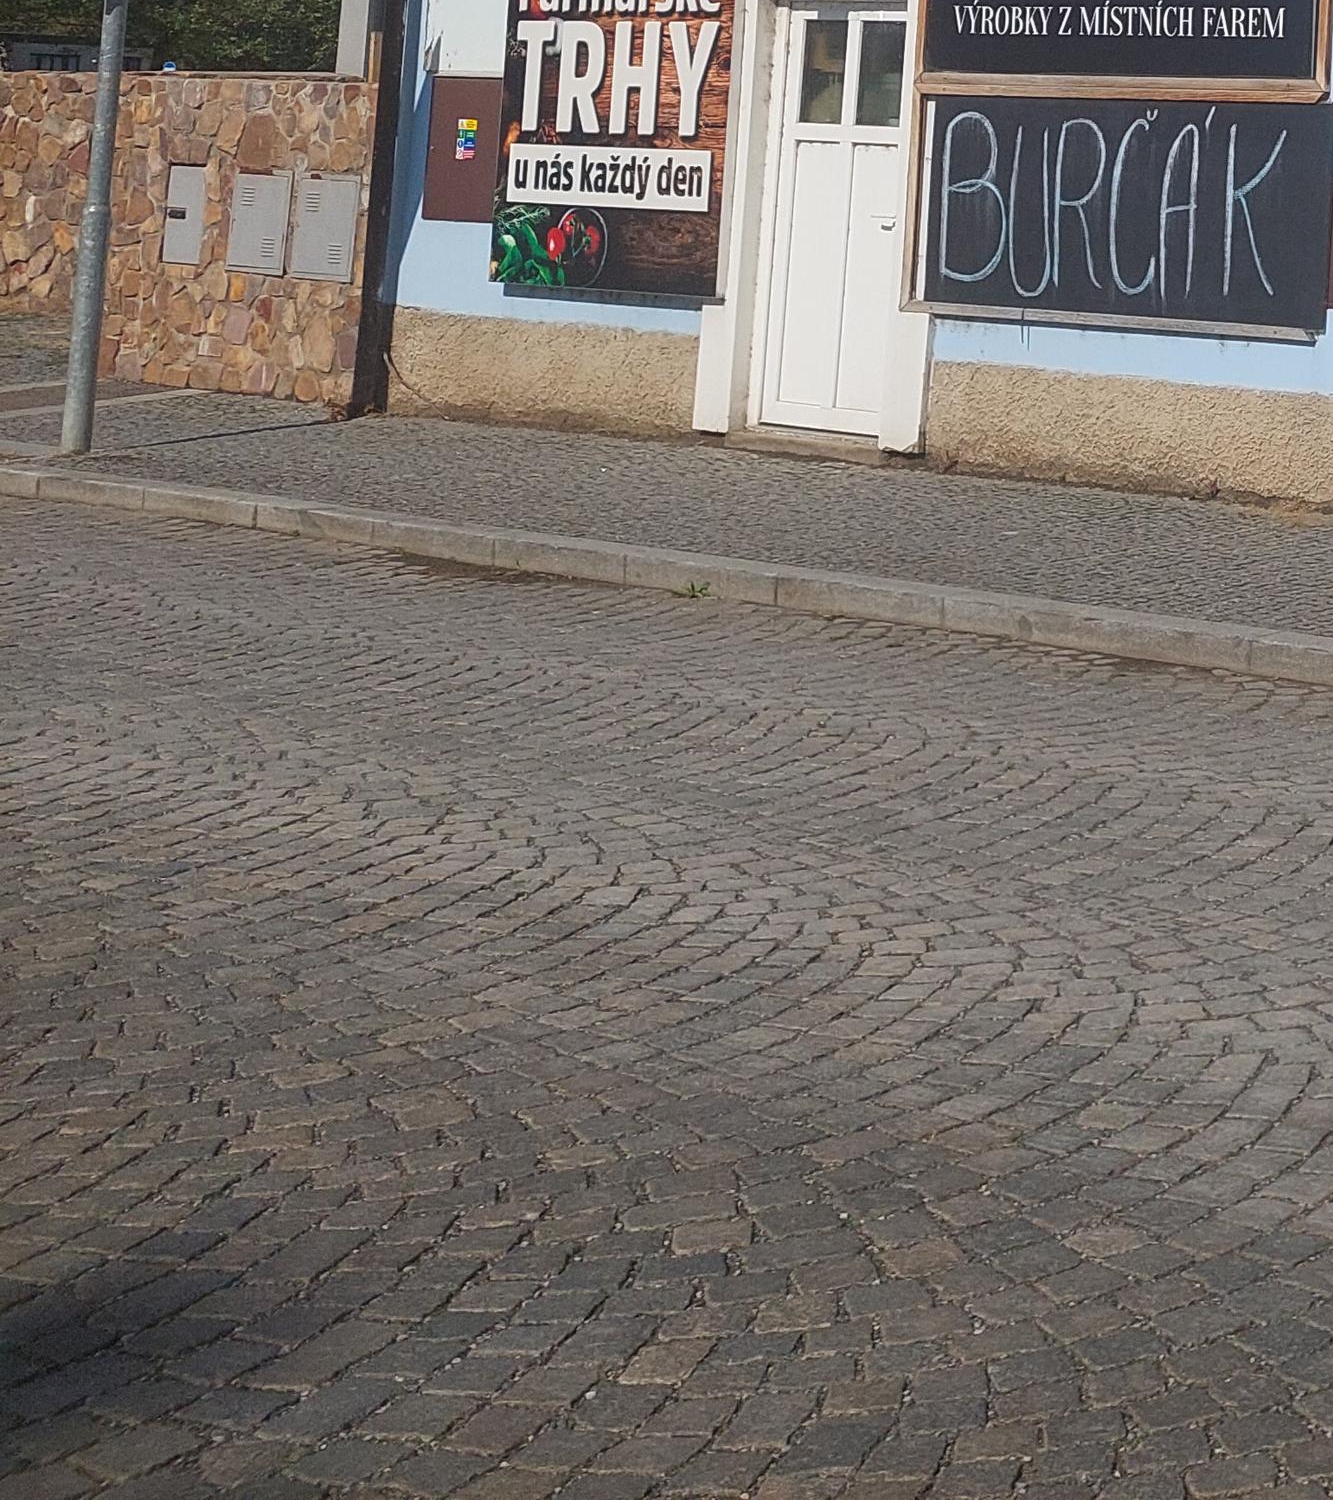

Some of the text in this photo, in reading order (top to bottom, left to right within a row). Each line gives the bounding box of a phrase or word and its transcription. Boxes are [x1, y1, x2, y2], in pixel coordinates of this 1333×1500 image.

[954, 0, 1286, 39] VÝROBKY Z MÍSTNÍCH FAREM
[516, 19, 723, 138] TRHY
[514, 152, 704, 202] u nás každý den
[939, 106, 1288, 301] BURČÁK
